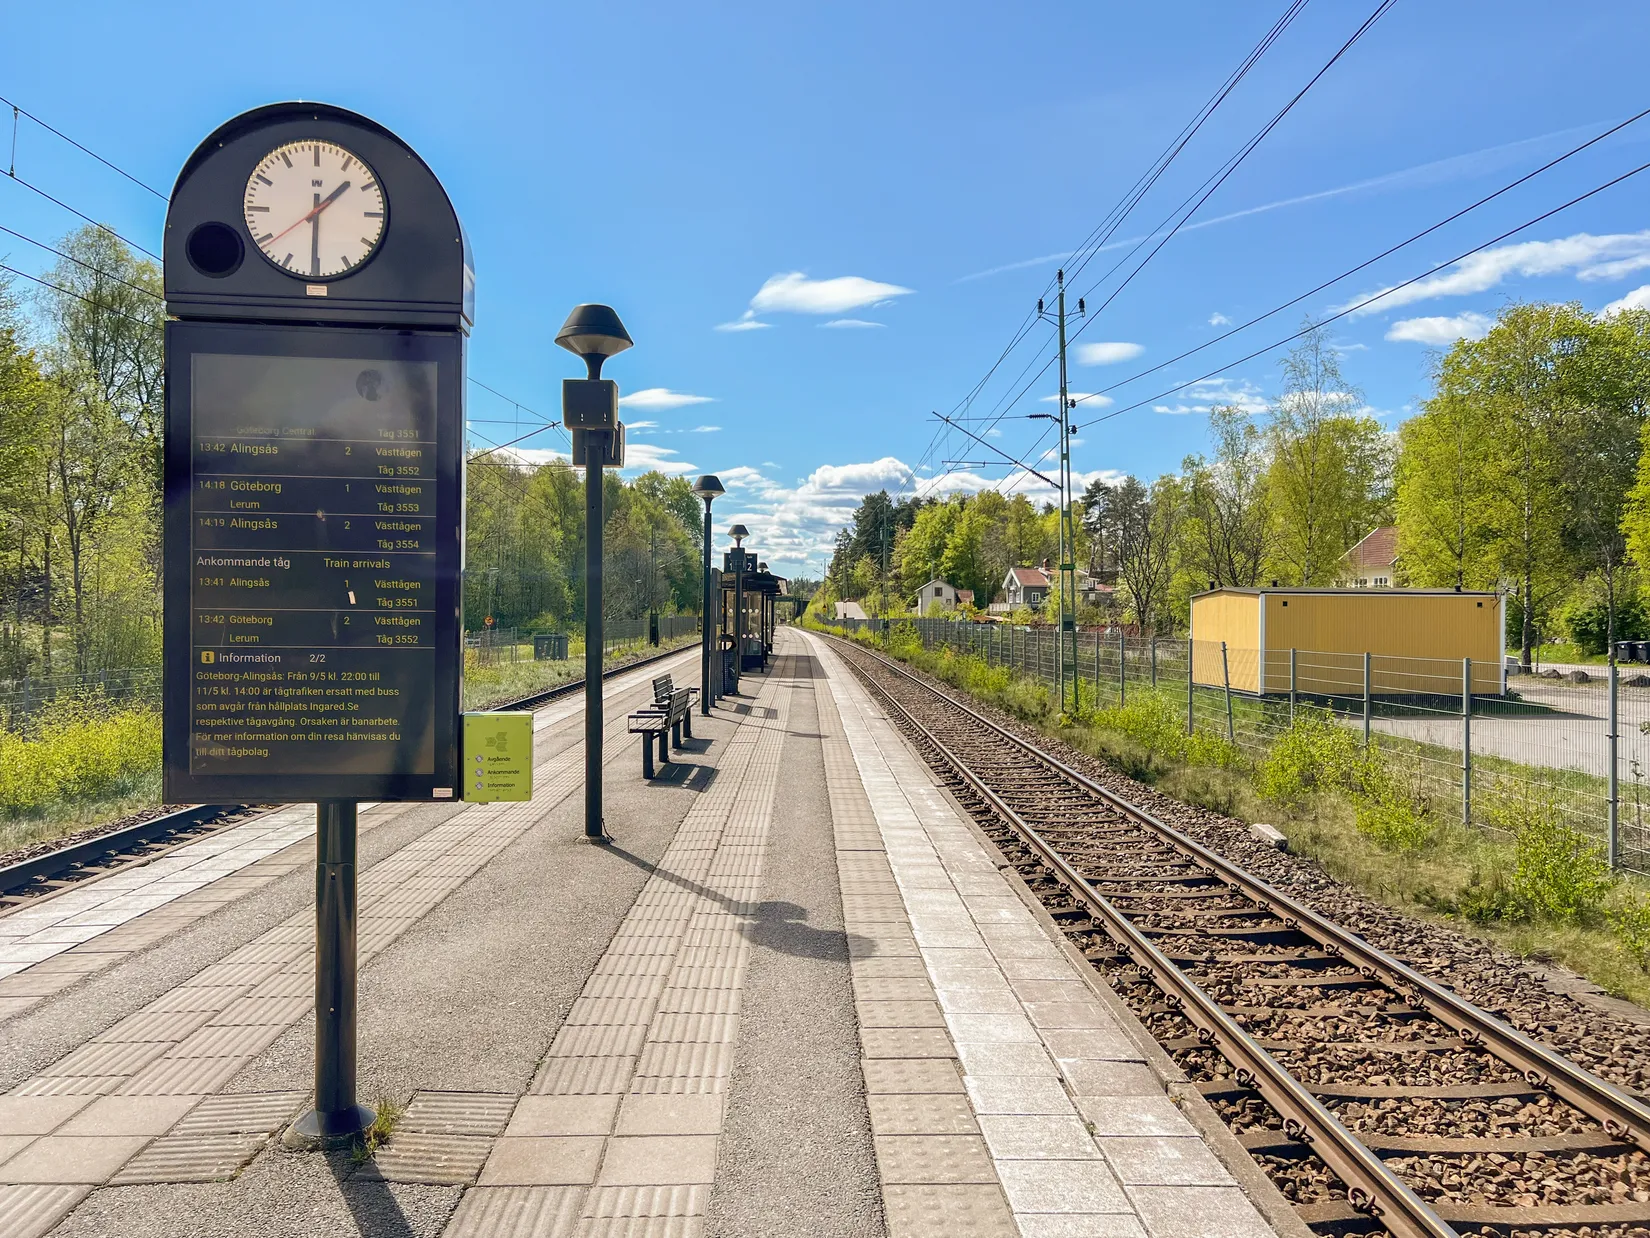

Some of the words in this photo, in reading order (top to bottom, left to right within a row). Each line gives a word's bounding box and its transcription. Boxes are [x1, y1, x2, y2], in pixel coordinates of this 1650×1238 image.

[378, 429, 394, 440] Tåg
[397, 429, 419, 438] 3551
[200, 443, 226, 452] 13:42
[230, 443, 278, 456] Alingsås
[345, 446, 351, 456] 2
[375, 447, 422, 458] Västtågen
[377, 465, 394, 476] Tåg
[396, 466, 420, 476] 3552
[200, 481, 226, 490] 14:18
[230, 480, 282, 494] Göteborg
[345, 484, 350, 492] 1
[375, 484, 422, 496] Västtågen
[230, 500, 260, 509] Lerum
[377, 502, 394, 513] Tåg
[396, 503, 420, 512] 3553
[199, 518, 225, 527] 14:19
[230, 518, 278, 531] Alingsås
[344, 521, 350, 530] 2
[375, 521, 422, 532] Västtågen
[377, 539, 394, 550] Tåg
[395, 540, 420, 549] 3554
[196, 556, 271, 567] Ankommande
[273, 557, 291, 570] tåg
[324, 558, 350, 568] Train
[352, 559, 391, 569] arrivals
[747, 563, 752, 571] 2
[199, 578, 224, 586] 13:41
[229, 578, 270, 588] Alingsås
[344, 580, 349, 588] 1
[374, 580, 421, 591] Västtågen
[376, 598, 393, 608] Tåg
[395, 599, 418, 607] 3551
[199, 615, 225, 624] 13:42
[229, 615, 273, 626] Göteborg
[343, 616, 350, 625] 2
[374, 617, 421, 628] Västtågen
[229, 634, 260, 643] Lerum
[376, 634, 393, 645] Tåg
[395, 635, 418, 644] 3552
[219, 653, 281, 663] Information
[310, 654, 326, 663] 2/2
[196, 672, 285, 682] Göteborg-Alingsås:
[287, 672, 308, 680] Från
[310, 672, 326, 681] 9/5
[328, 672, 338, 680] kl.
[341, 672, 367, 681] 22:00
[369, 672, 380, 681] till
[197, 687, 219, 696] 11/5
[221, 687, 231, 696] kl.
[234, 687, 260, 696] 14:00
[262, 687, 272, 696] är
[274, 687, 324, 698] tågtrafiken
[326, 688, 353, 696] ersatt
[355, 687, 375, 696] med
[377, 687, 400, 696] buss
[196, 703, 217, 711] som
[220, 702, 245, 712] avgår
[248, 702, 266, 711] från
[268, 702, 308, 712] hållplats
[310, 702, 359, 712] Ingared.Se
[196, 717, 244, 727] respektive
[246, 717, 298, 728] tågavgång.
[300, 717, 338, 726] Orsaken
[340, 717, 350, 726] är
[351, 717, 400, 726] banarbete.
[196, 732, 211, 741] För
[214, 733, 232, 741] mer
[234, 732, 288, 741] information
[290, 733, 306, 741] om
[308, 732, 322, 741] din
[324, 733, 344, 741] resa
[346, 732, 387, 741] hänvisas
[389, 732, 401, 741] du
[196, 748, 207, 756] till
[209, 747, 225, 756] ditt
[227, 747, 271, 758] tågbolag.
